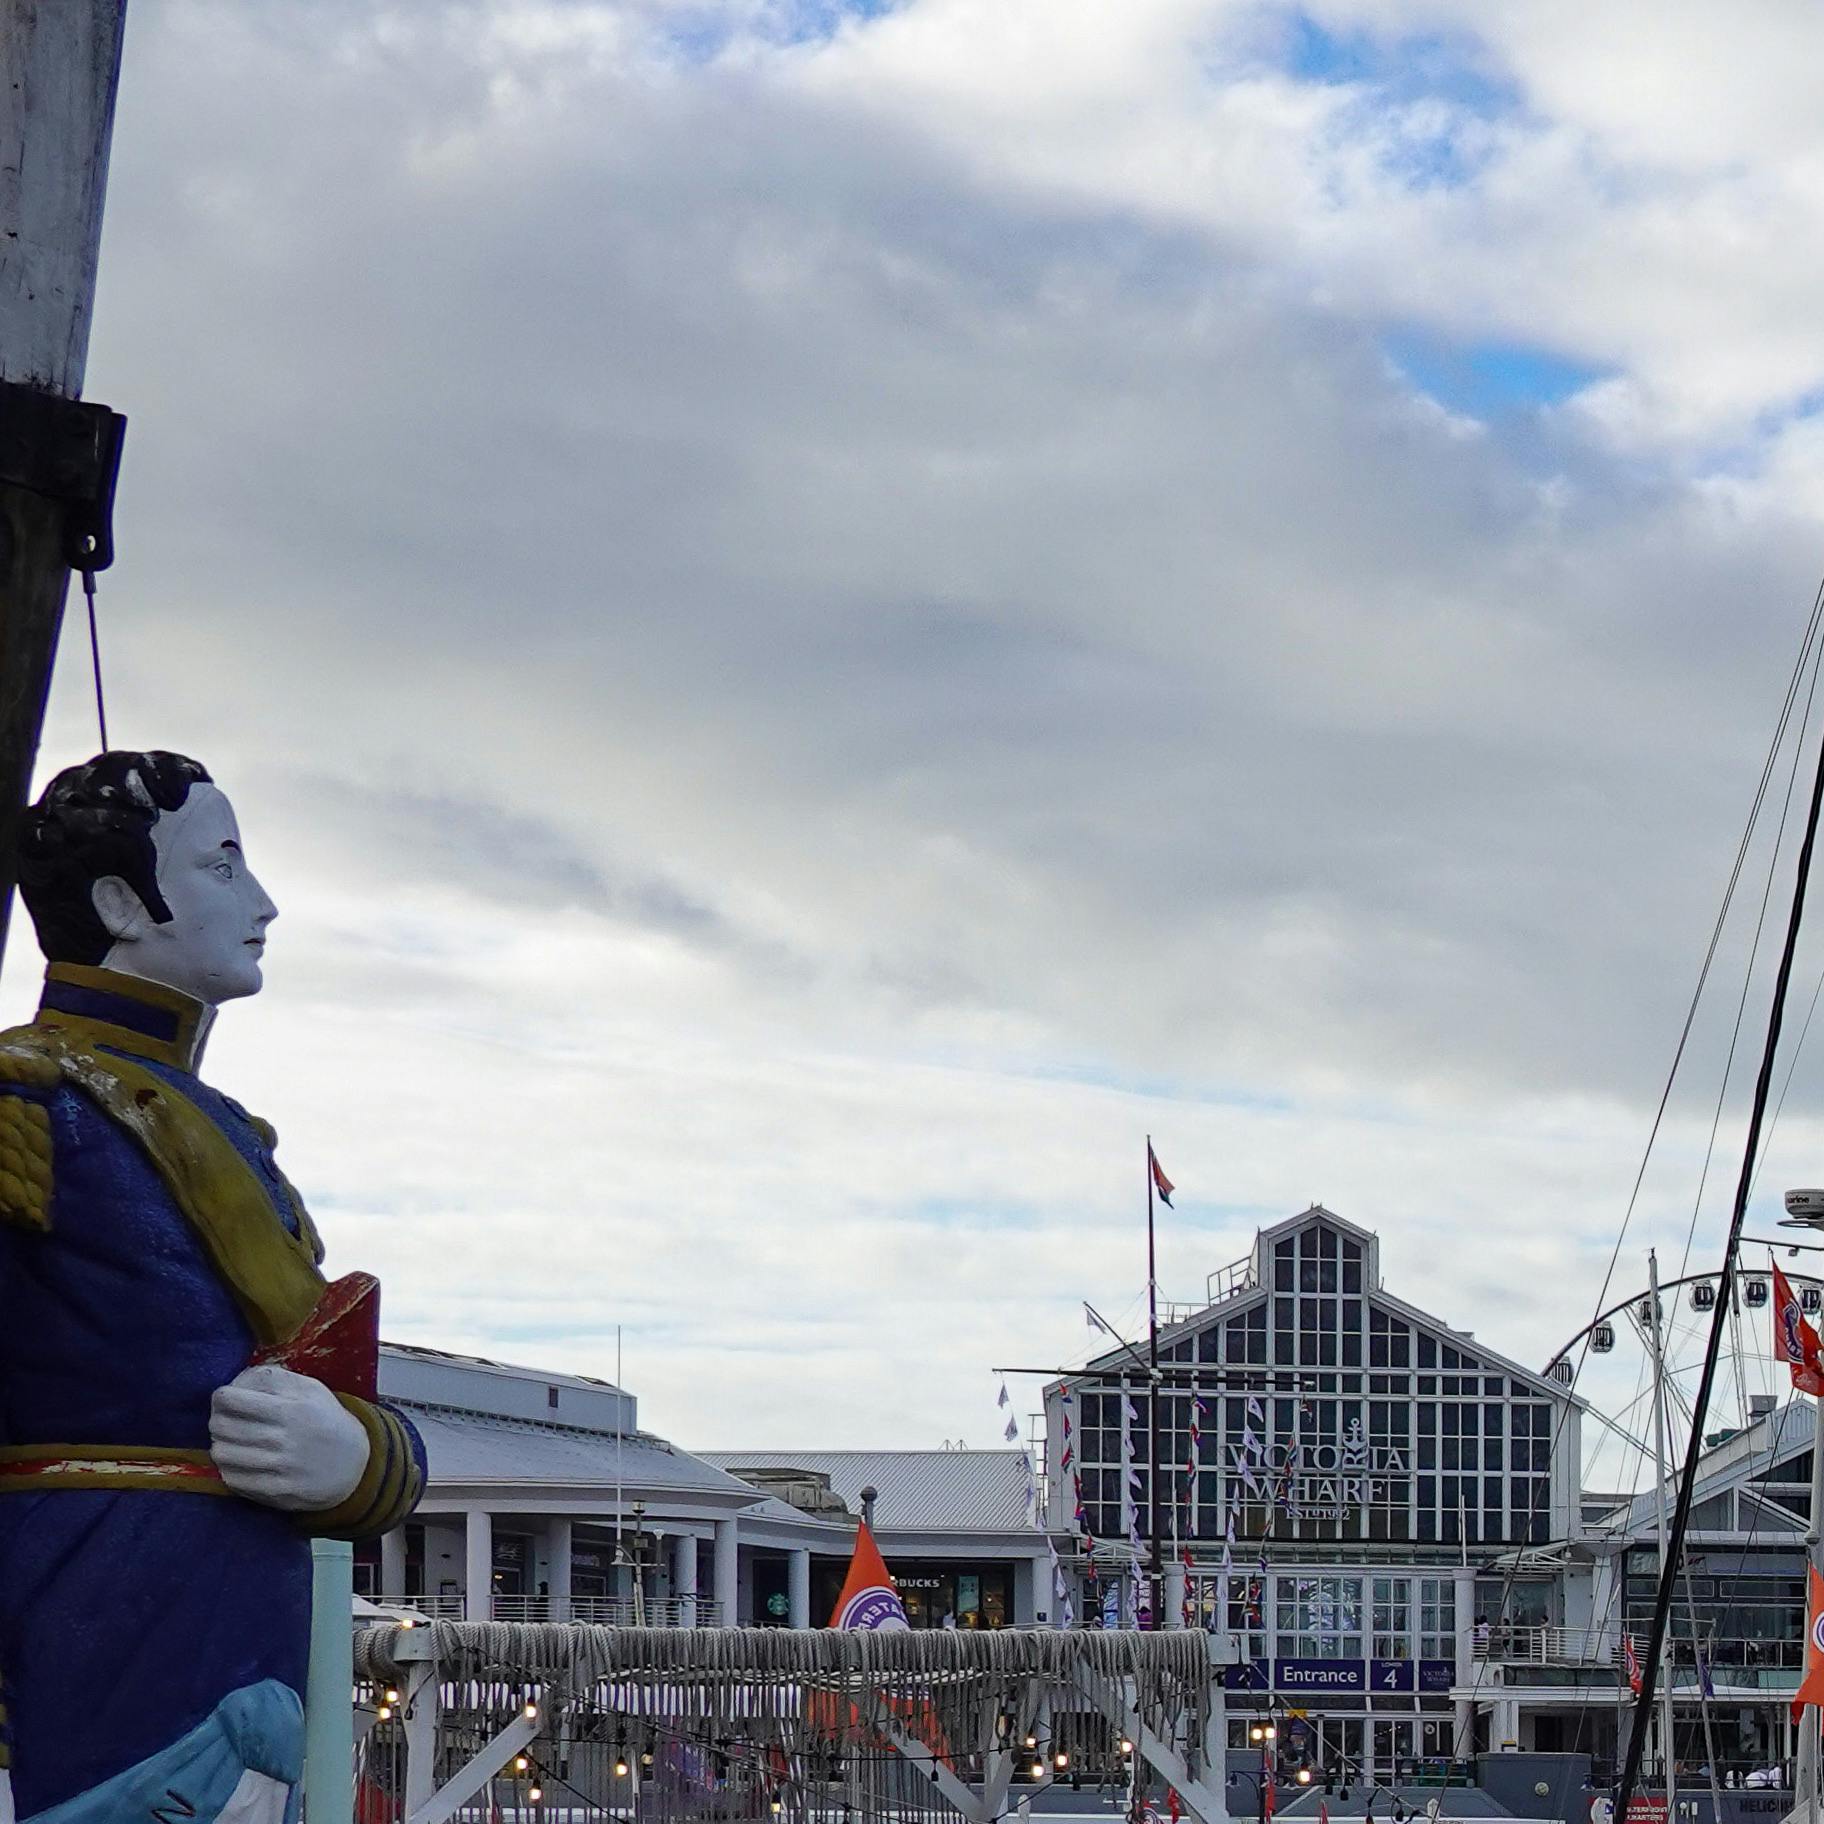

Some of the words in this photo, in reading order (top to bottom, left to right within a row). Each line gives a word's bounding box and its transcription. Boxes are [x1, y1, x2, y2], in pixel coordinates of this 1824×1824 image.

[1227, 1443, 1406, 1471] VICTORIA
[1251, 1475, 1386, 1503] WHARF
[892, 1579, 940, 1588] RBUCKS
[1283, 1666, 1358, 1683] Entrance
[1384, 1669, 1398, 1688] 4
